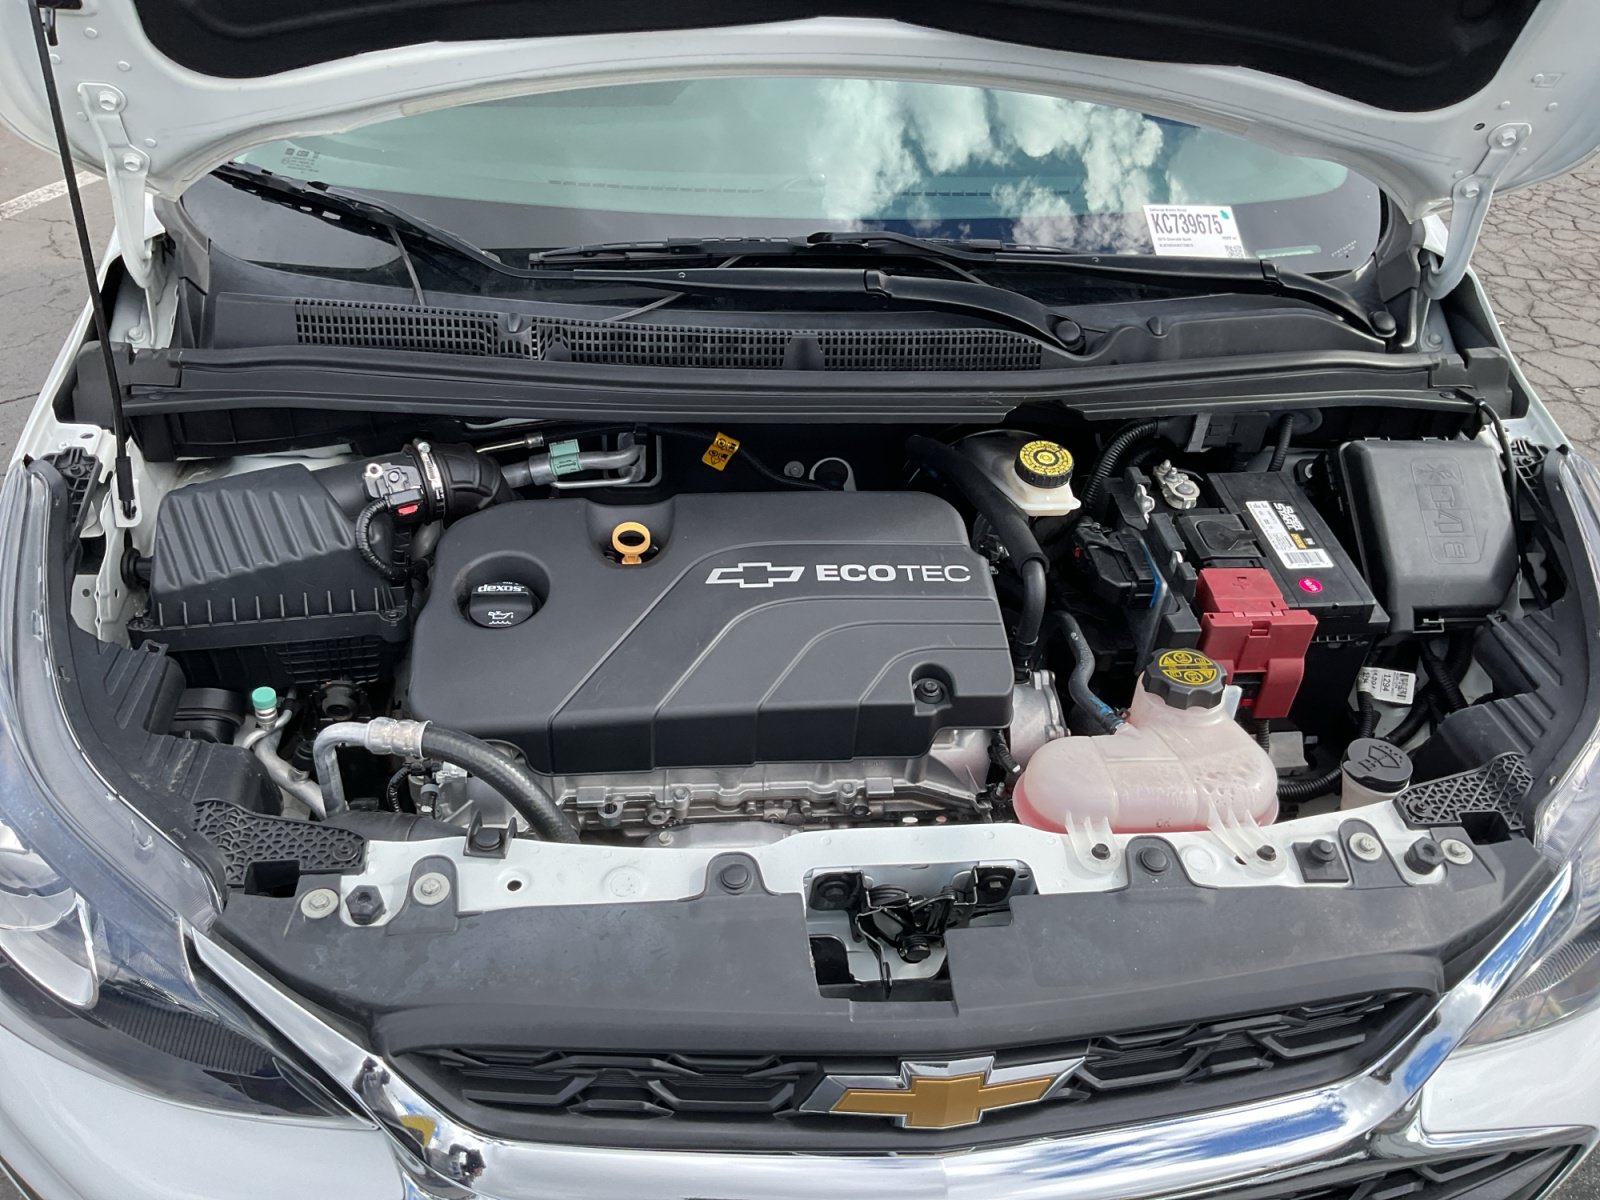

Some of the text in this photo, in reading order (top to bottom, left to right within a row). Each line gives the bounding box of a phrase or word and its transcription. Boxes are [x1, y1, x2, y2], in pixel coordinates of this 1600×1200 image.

[1151, 213, 1223, 234] KC739675
[816, 564, 971, 583] ECOTEC
[477, 583, 522, 592] dexos
